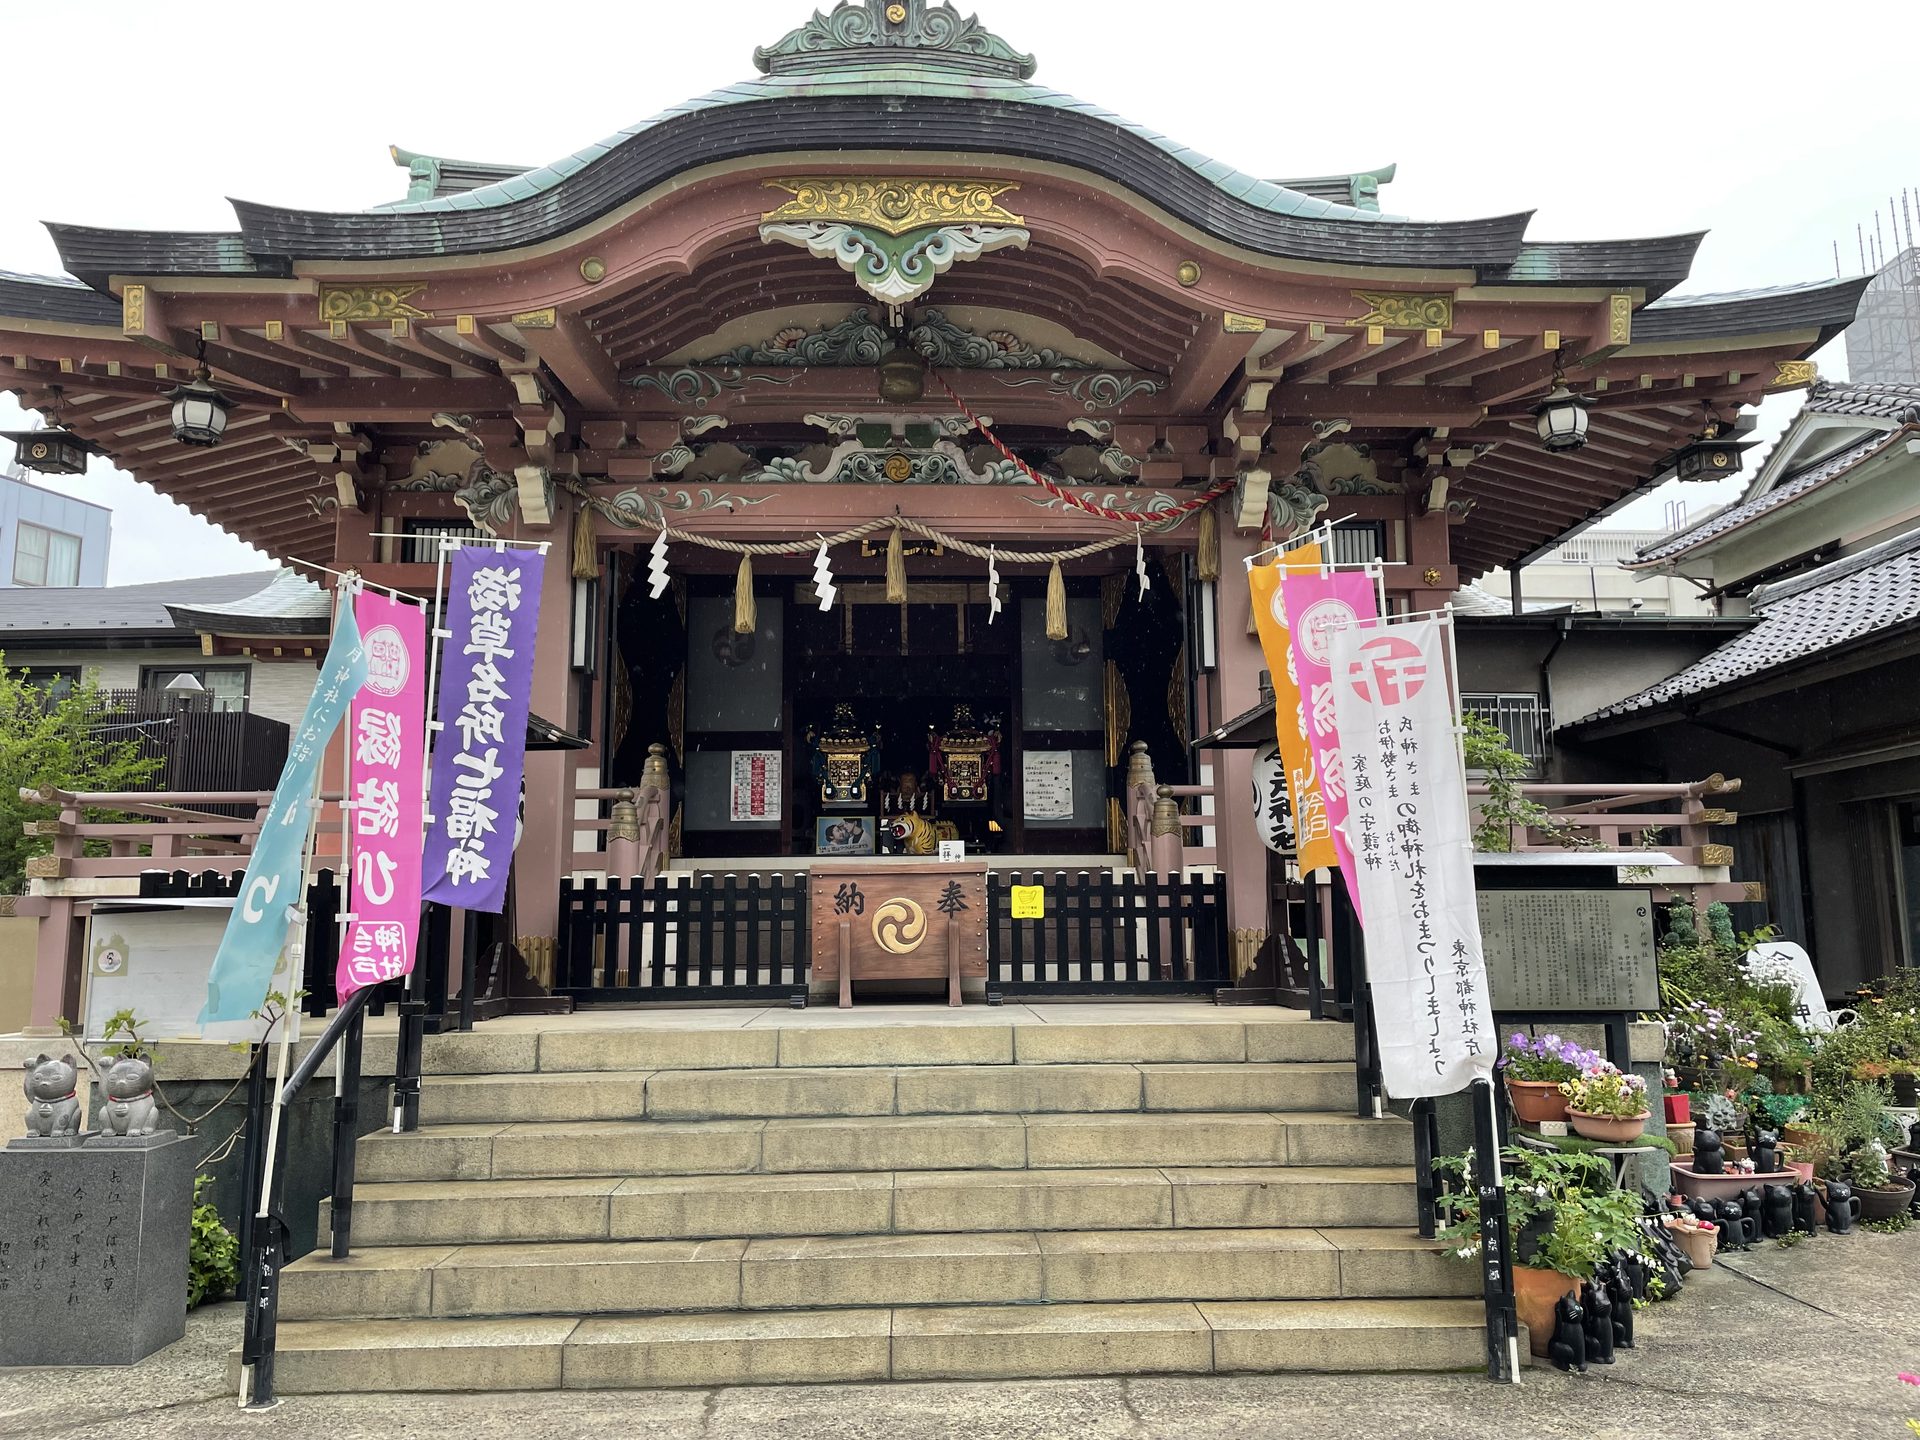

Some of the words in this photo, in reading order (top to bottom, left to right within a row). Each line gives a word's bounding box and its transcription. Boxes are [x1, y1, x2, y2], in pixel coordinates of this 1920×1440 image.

[67, 1187, 88, 1306] 今戸で生まれ
